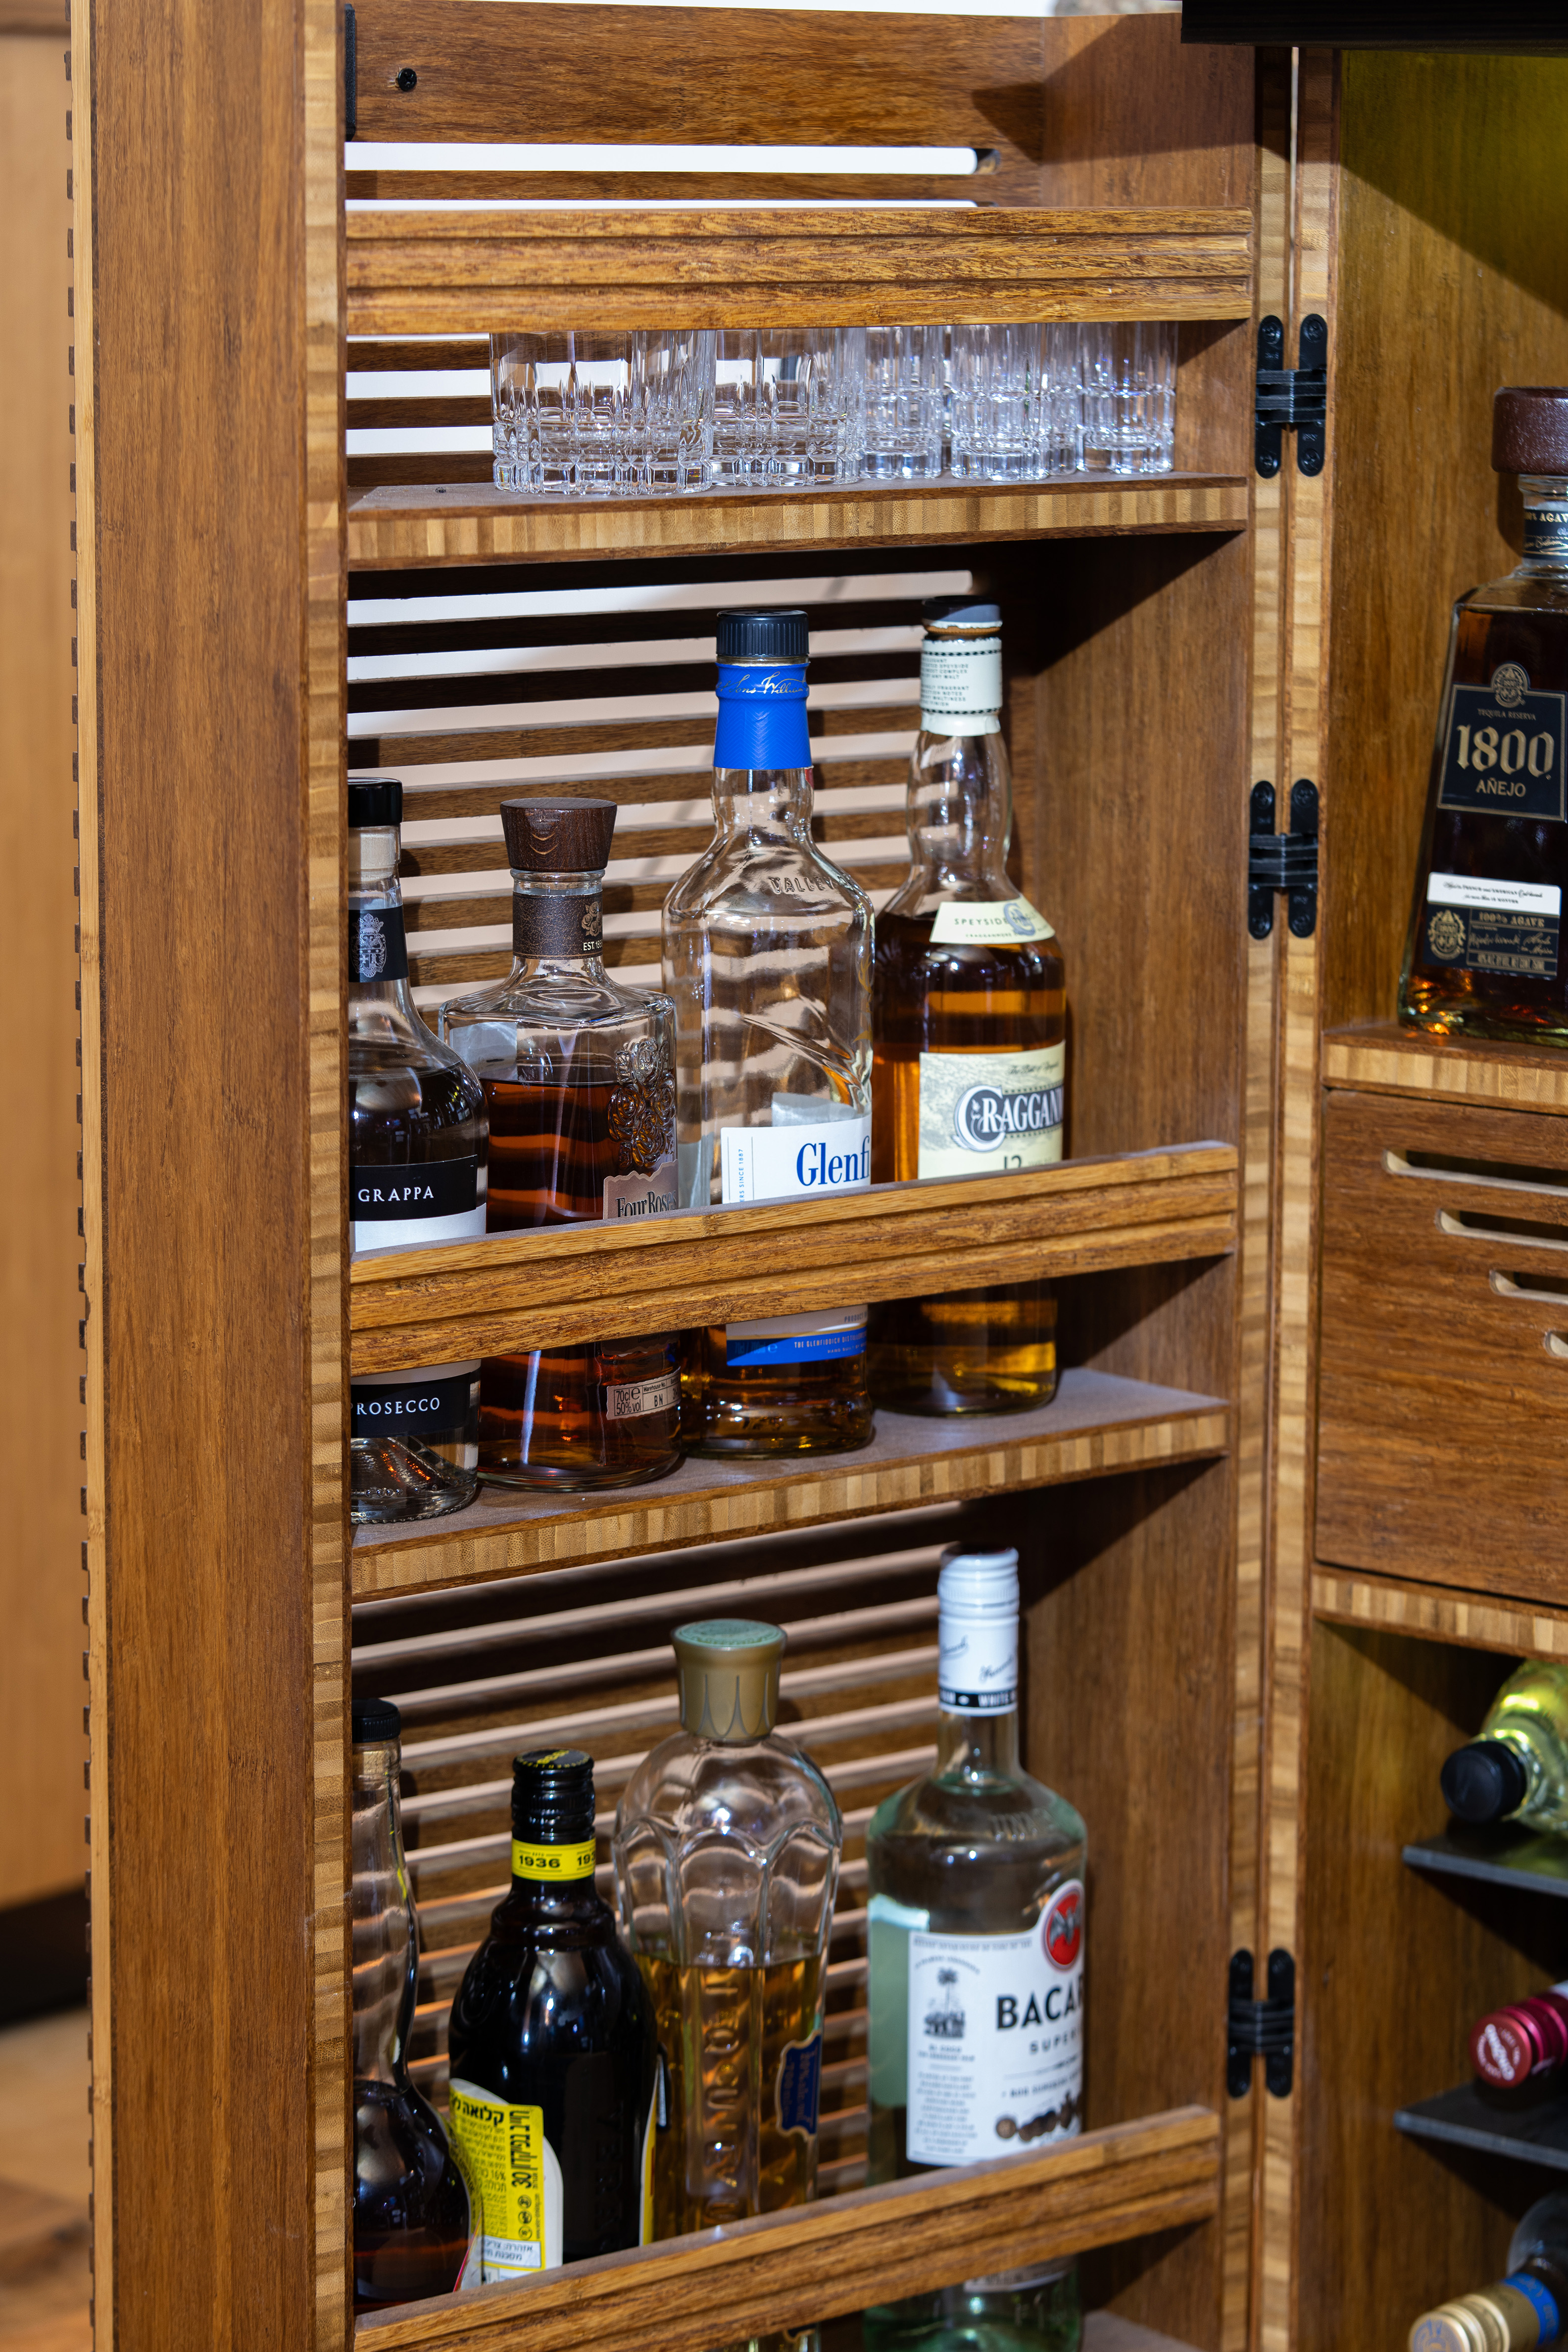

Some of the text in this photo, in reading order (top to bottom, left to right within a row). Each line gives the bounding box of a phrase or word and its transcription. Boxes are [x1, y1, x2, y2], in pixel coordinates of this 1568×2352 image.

[1477, 708, 1536, 721] TEQUILA RESERVA
[1457, 725, 1555, 778] 1800
[1475, 778, 1526, 797] AÑEJO
[768, 876, 838, 894] VALLEY
[1479, 912, 1545, 928] 100% AGAVE
[583, 941, 595, 951] EST.
[358, 1186, 434, 1202] GRAPPA
[615, 1190, 677, 1218] Four Roses
[806, 1337, 840, 1348] GLENFIDDICH
[616, 1387, 640, 1403] 70cl e
[643, 1383, 661, 1392] Warehouse
[616, 1399, 641, 1415] 50% vol
[520, 1855, 561, 1868] 1936
[463, 2101, 504, 2127] קלואה
[509, 2110, 530, 2131] חייב
[510, 2134, 539, 2171] בפיקדון
[511, 2172, 532, 2189] 30
